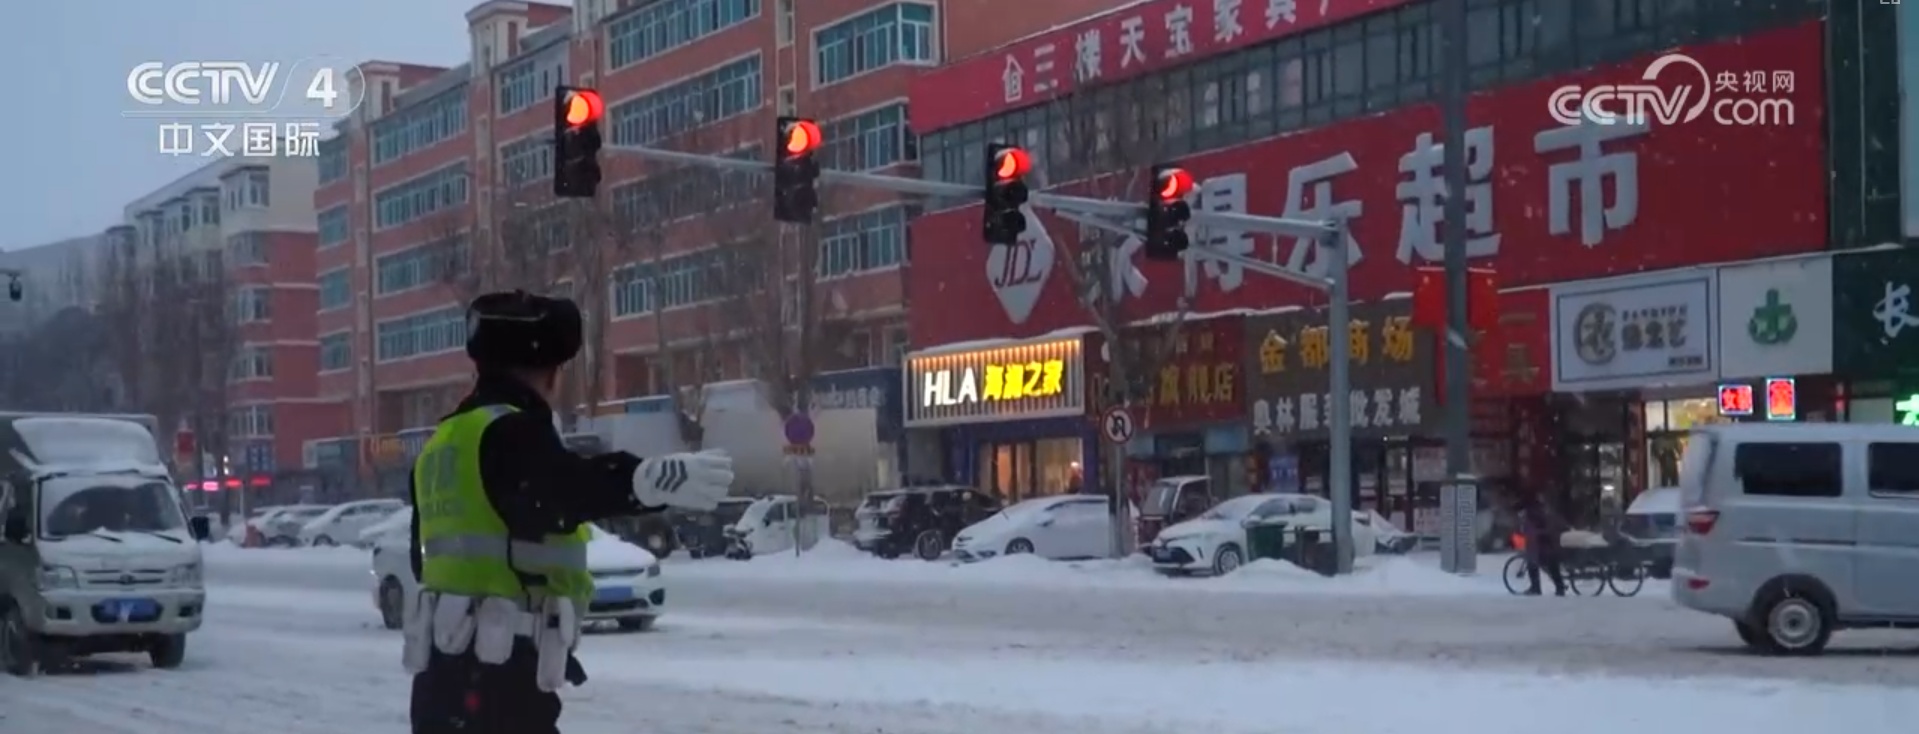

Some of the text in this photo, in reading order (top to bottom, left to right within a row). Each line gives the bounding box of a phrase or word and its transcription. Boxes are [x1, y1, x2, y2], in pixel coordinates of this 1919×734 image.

[1033, 0, 1330, 94] 三楼天宝家具
[994, 238, 1043, 288] JDL
[1258, 315, 1415, 374] 金都商场
[923, 366, 978, 407] HLA
[982, 359, 1064, 401] 海澜之家
